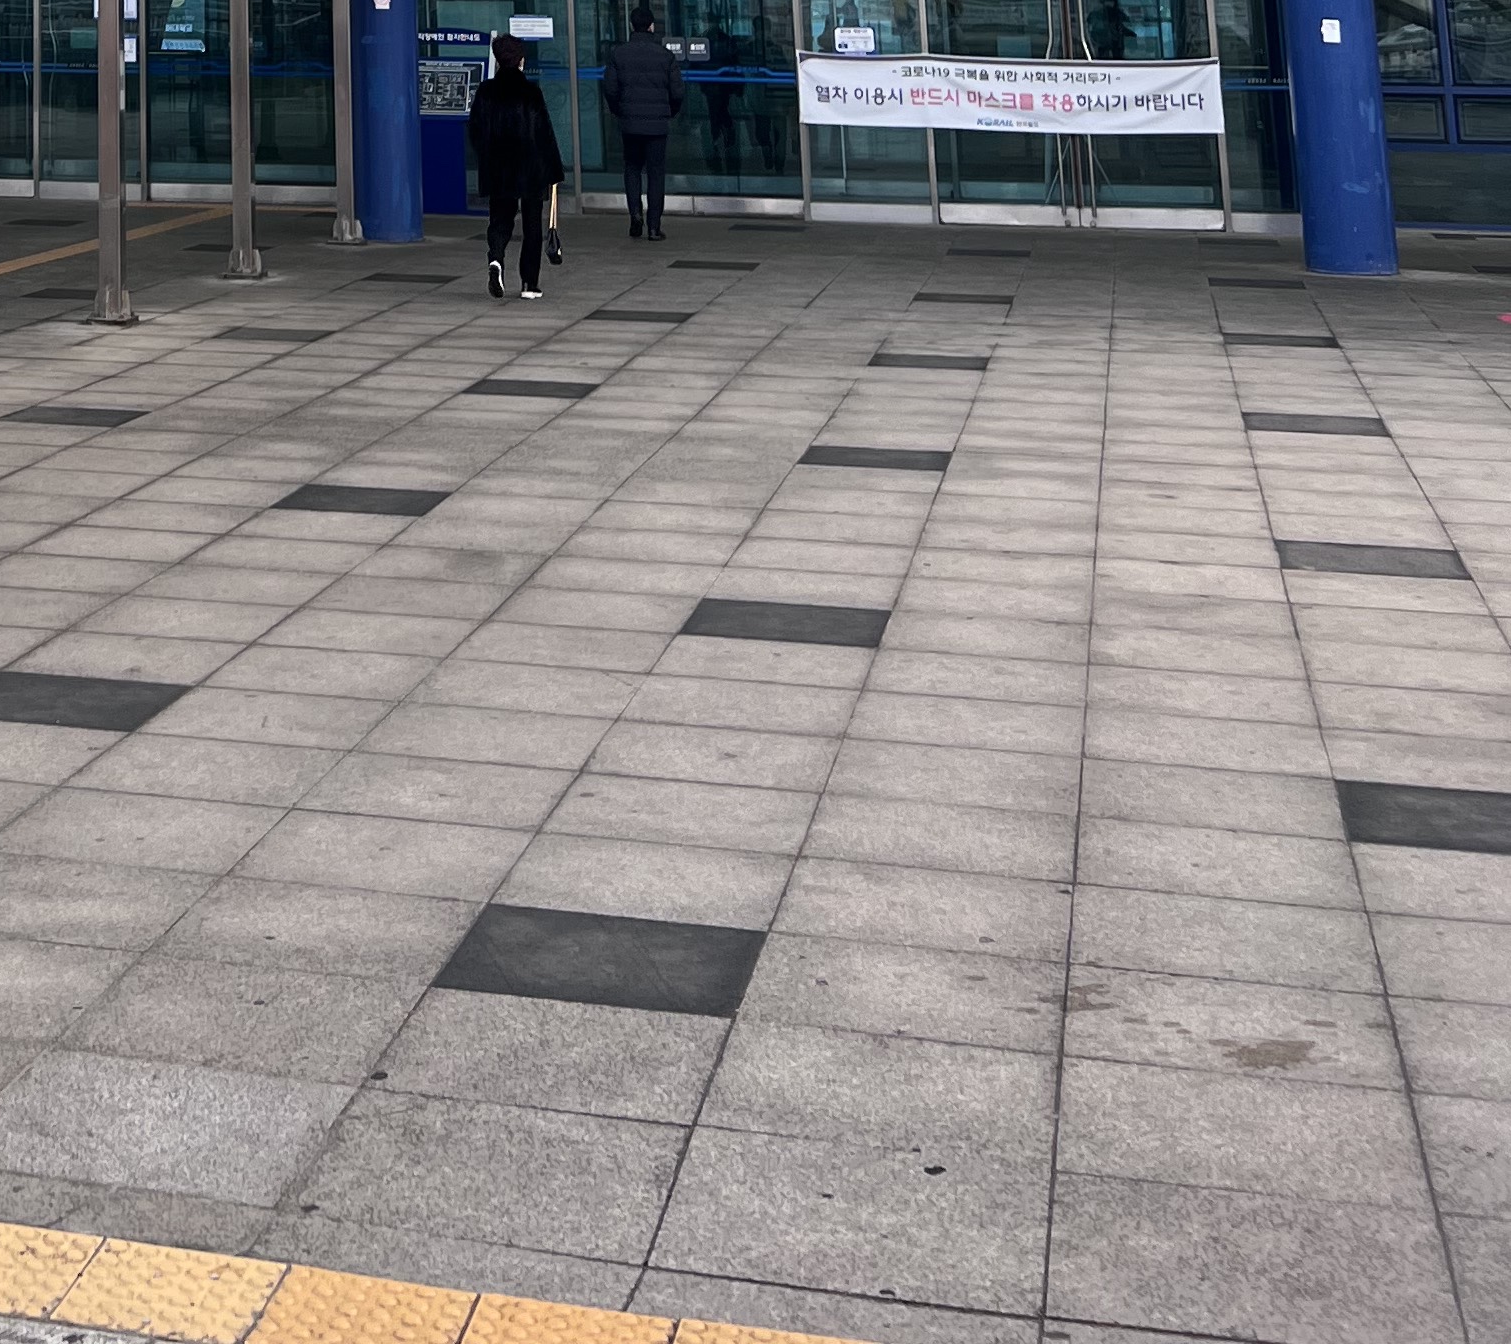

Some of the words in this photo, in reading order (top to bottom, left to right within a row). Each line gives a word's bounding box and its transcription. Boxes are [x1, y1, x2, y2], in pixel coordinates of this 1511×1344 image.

[900, 65, 951, 79] 코로나19
[994, 68, 1018, 83] 위한
[1021, 70, 1058, 84] 사회적
[1062, 71, 1112, 85] 거리두기
[815, 85, 848, 104] 열차
[854, 87, 904, 106] 이용시
[910, 88, 960, 107] 반드시
[966, 90, 1034, 111] 마스크를
[1041, 93, 1127, 113] 착용하시기
[1134, 92, 1205, 112] 바랍니다
